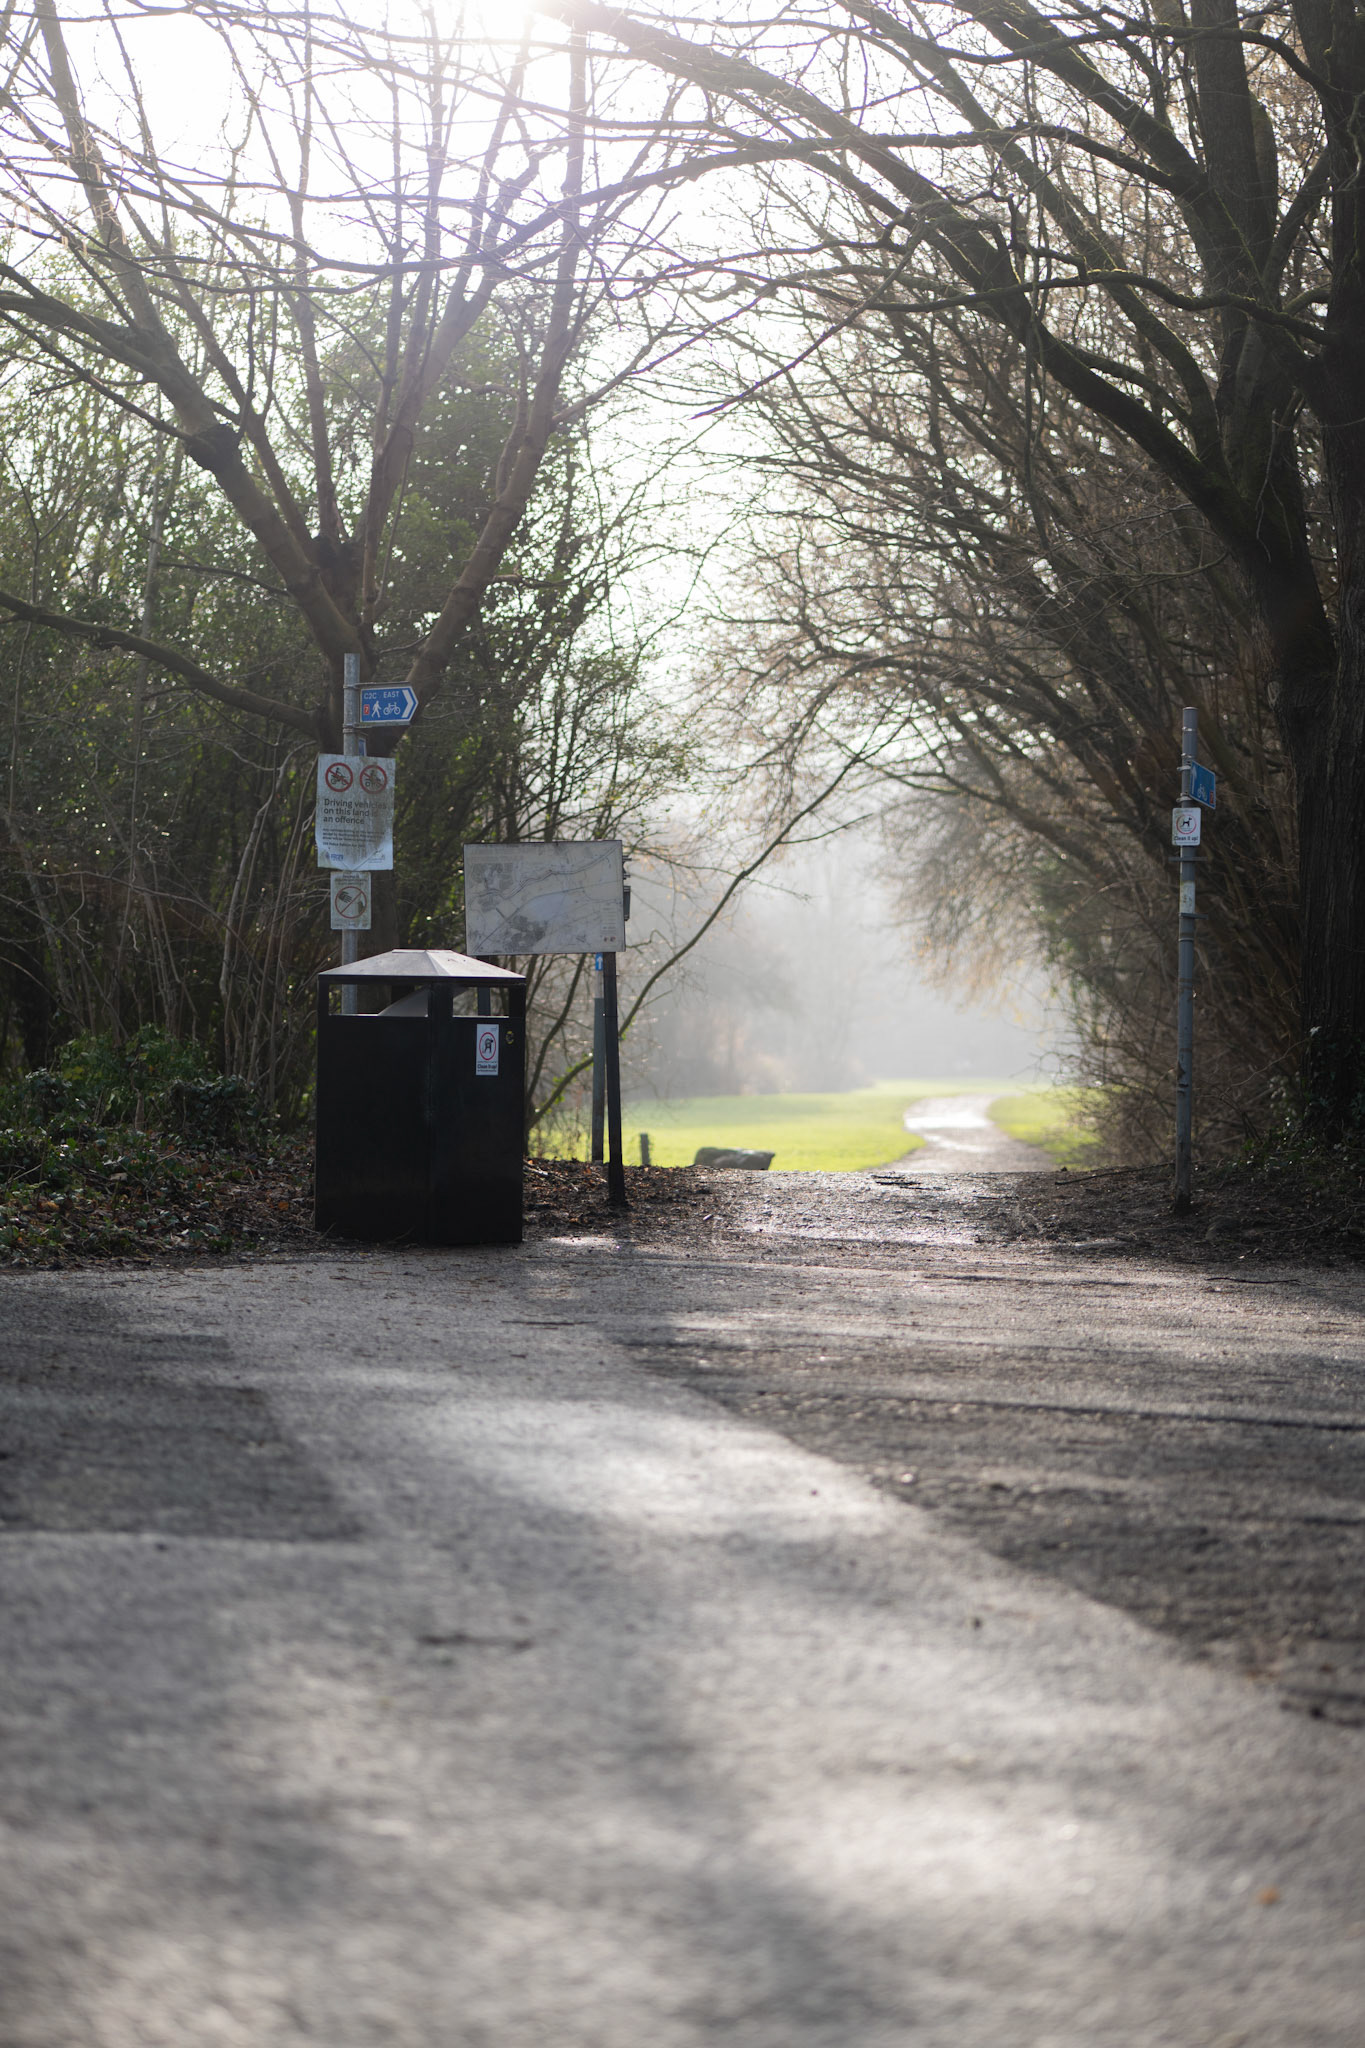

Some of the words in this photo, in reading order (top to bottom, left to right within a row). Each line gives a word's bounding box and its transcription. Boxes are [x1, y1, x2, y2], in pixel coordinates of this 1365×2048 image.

[383, 690, 400, 699] EAST
[324, 798, 353, 809] Driving
[354, 800, 387, 810] vehicles
[336, 807, 351, 816] this
[353, 808, 370, 817] land
[335, 816, 365, 825] offence
